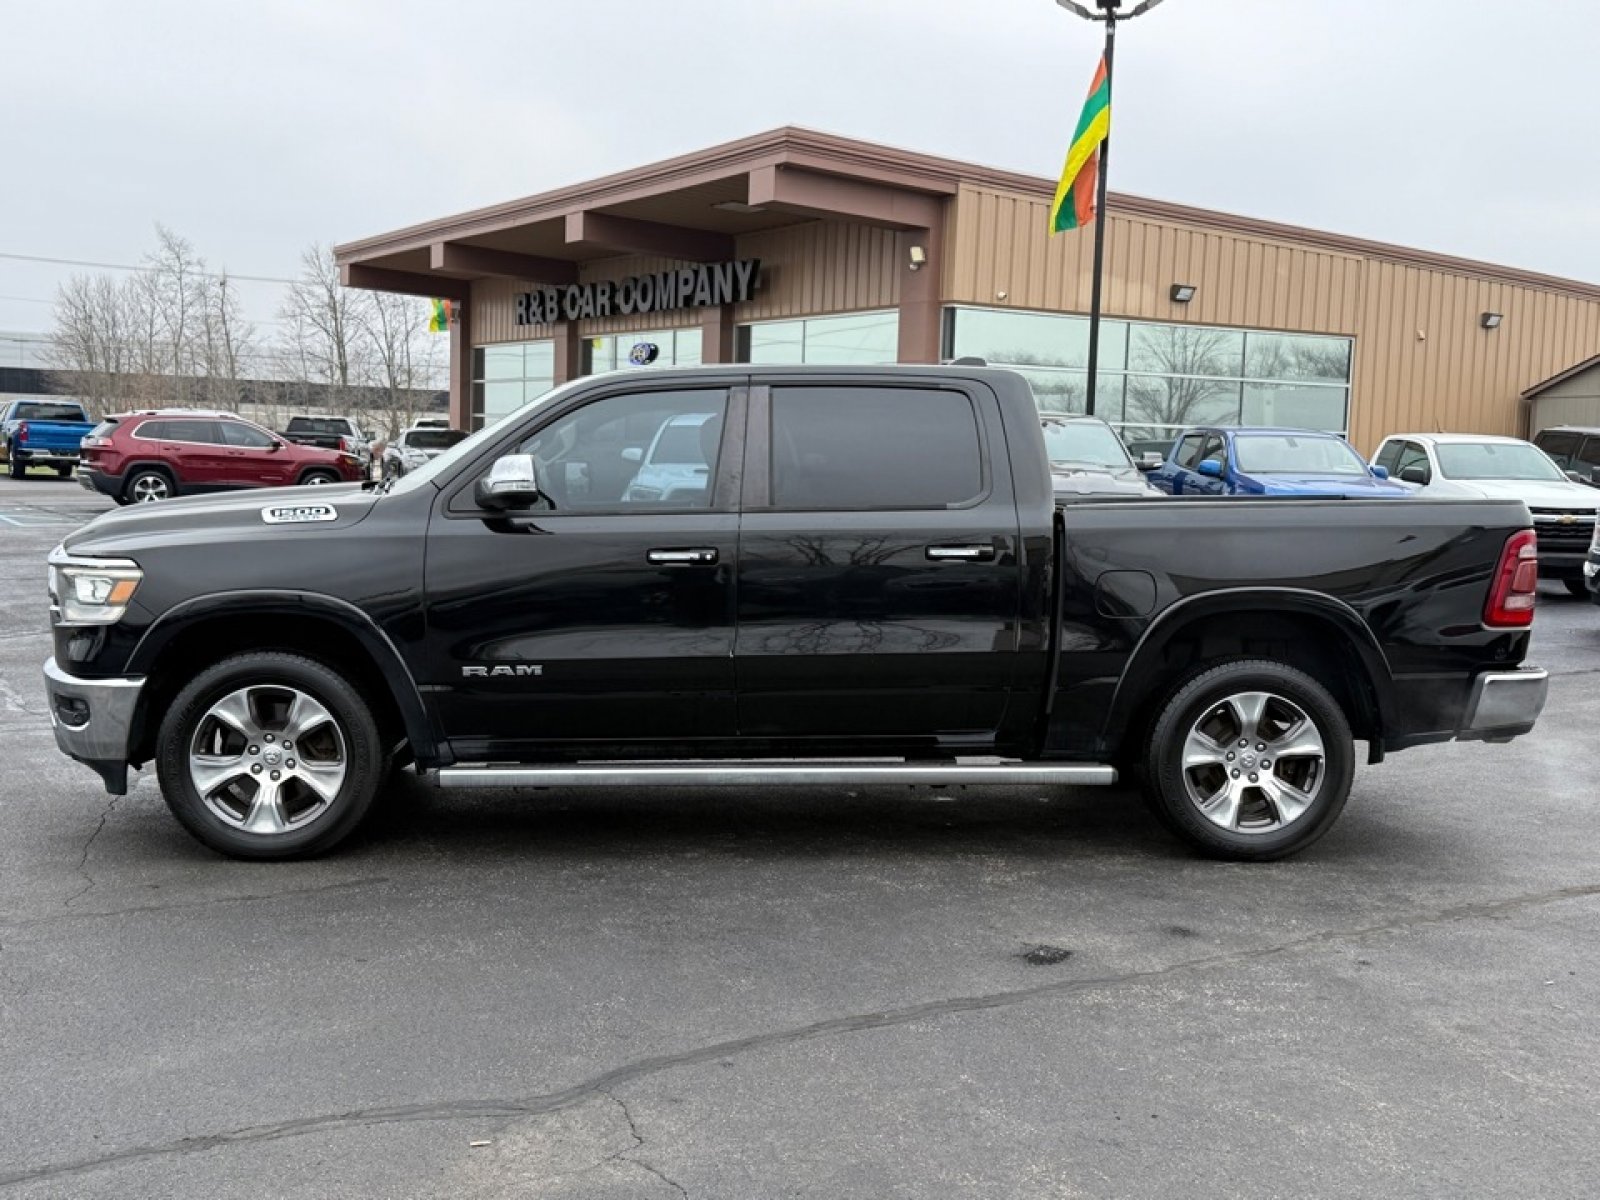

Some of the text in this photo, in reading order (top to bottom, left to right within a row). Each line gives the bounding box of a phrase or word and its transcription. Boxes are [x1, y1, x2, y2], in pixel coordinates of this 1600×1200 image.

[514, 261, 754, 325] R&B CAR COMPANY
[272, 506, 327, 517] 1500
[461, 664, 543, 677] RAM
